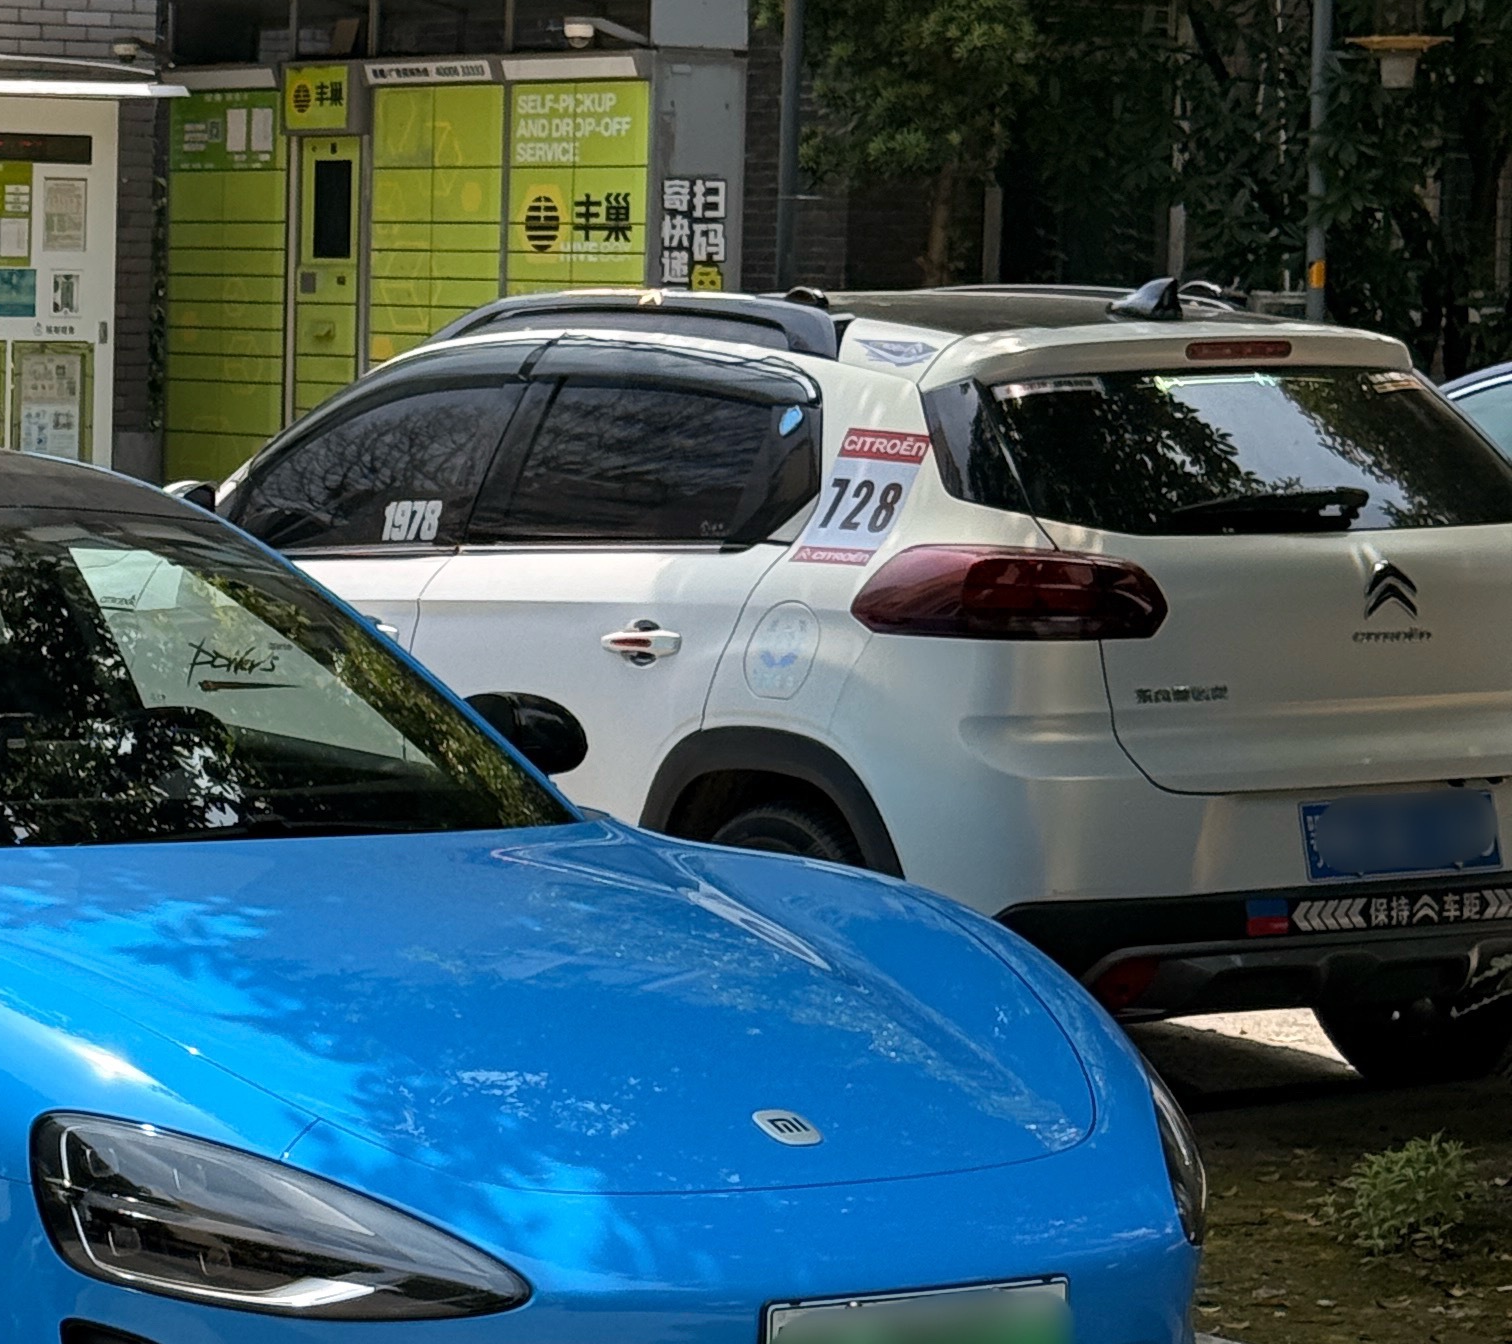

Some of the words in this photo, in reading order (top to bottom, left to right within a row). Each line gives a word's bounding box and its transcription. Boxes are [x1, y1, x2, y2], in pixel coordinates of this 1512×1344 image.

[315, 81, 343, 106] 丰巢
[516, 92, 617, 115] SELF-PICKUP
[516, 118, 549, 139] AND
[551, 116, 632, 138] DROP-OFF
[516, 142, 579, 163] SERVICE
[573, 192, 633, 242] 丰巢
[661, 179, 690, 284] 寄快递
[692, 179, 726, 262] 扫码
[381, 500, 443, 541] 1978
[818, 477, 903, 534] 728
[1370, 897, 1410, 927] 保持
[1442, 892, 1481, 922] 车距
